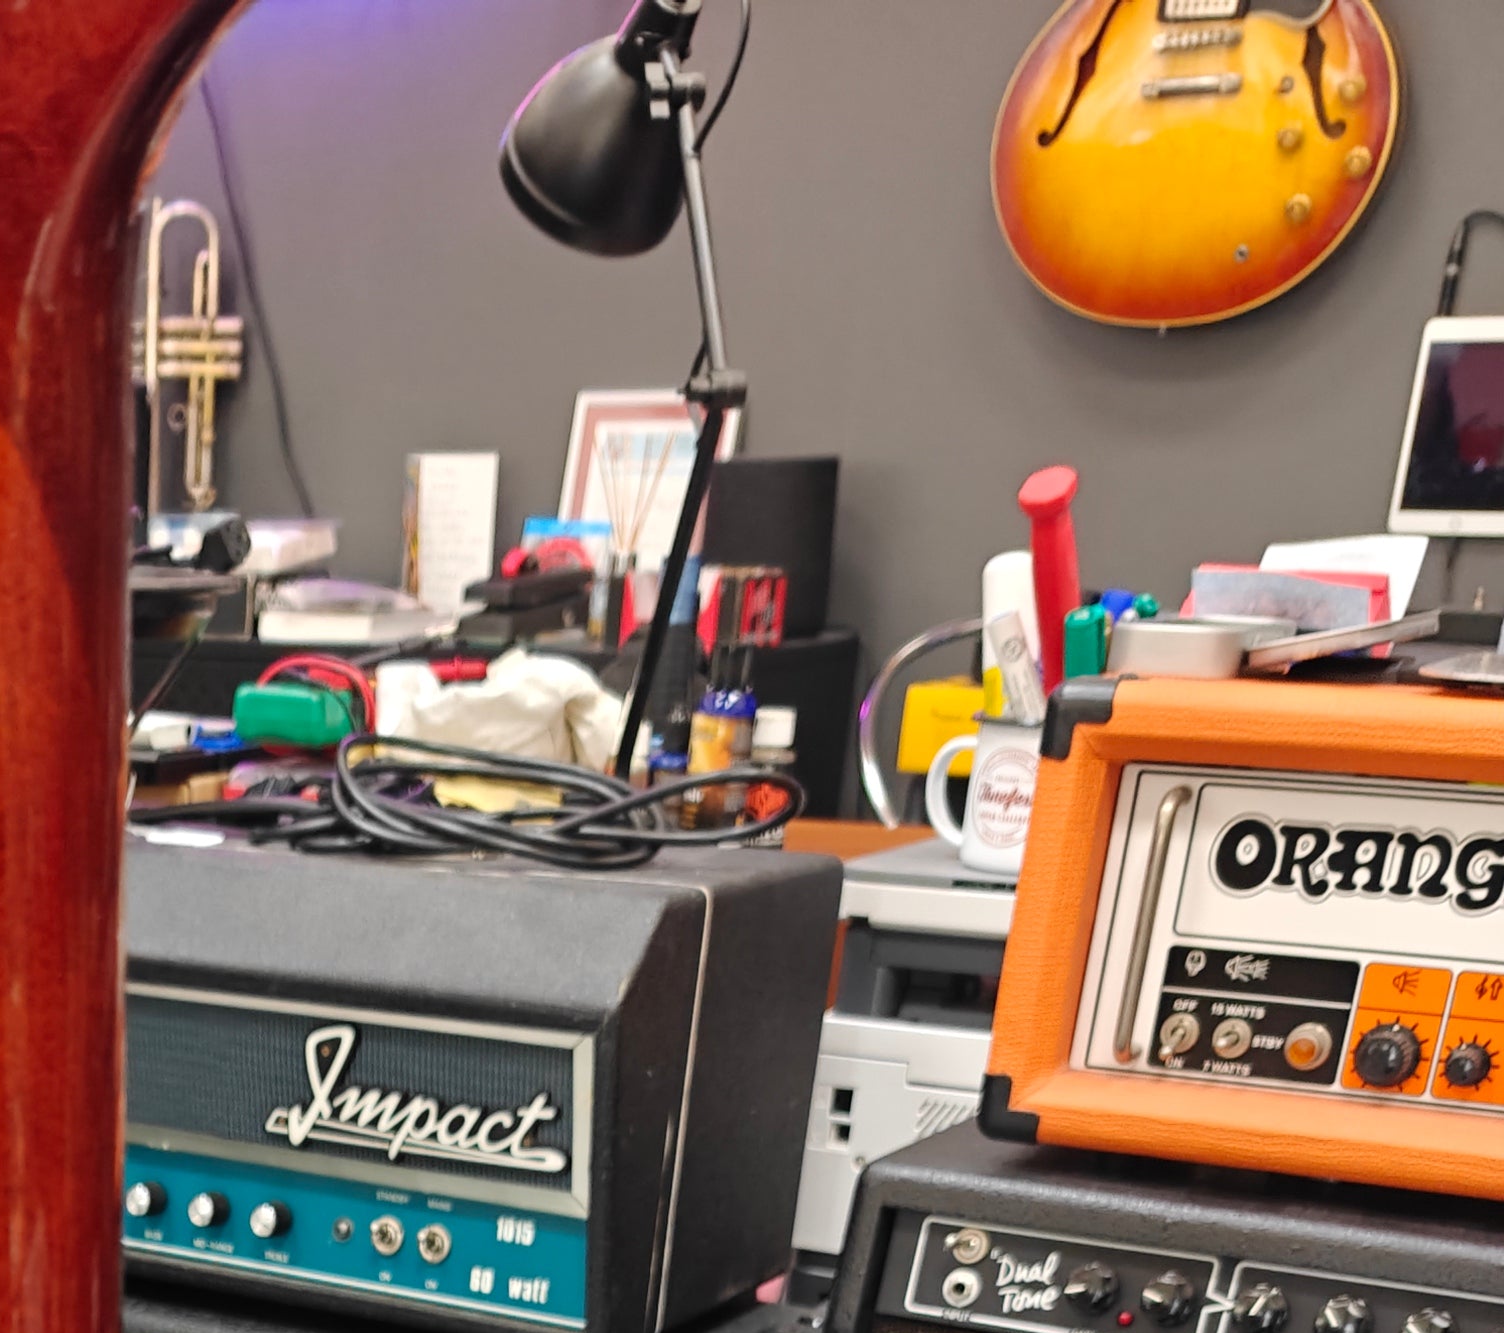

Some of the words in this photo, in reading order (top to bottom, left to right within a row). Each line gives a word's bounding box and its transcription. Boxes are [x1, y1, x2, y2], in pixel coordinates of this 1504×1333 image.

[1215, 818, 1504, 910] ORANG
[1226, 1004, 1266, 1020] WATTS
[284, 1024, 566, 1172] Impact
[508, 1276, 550, 1304] watt
